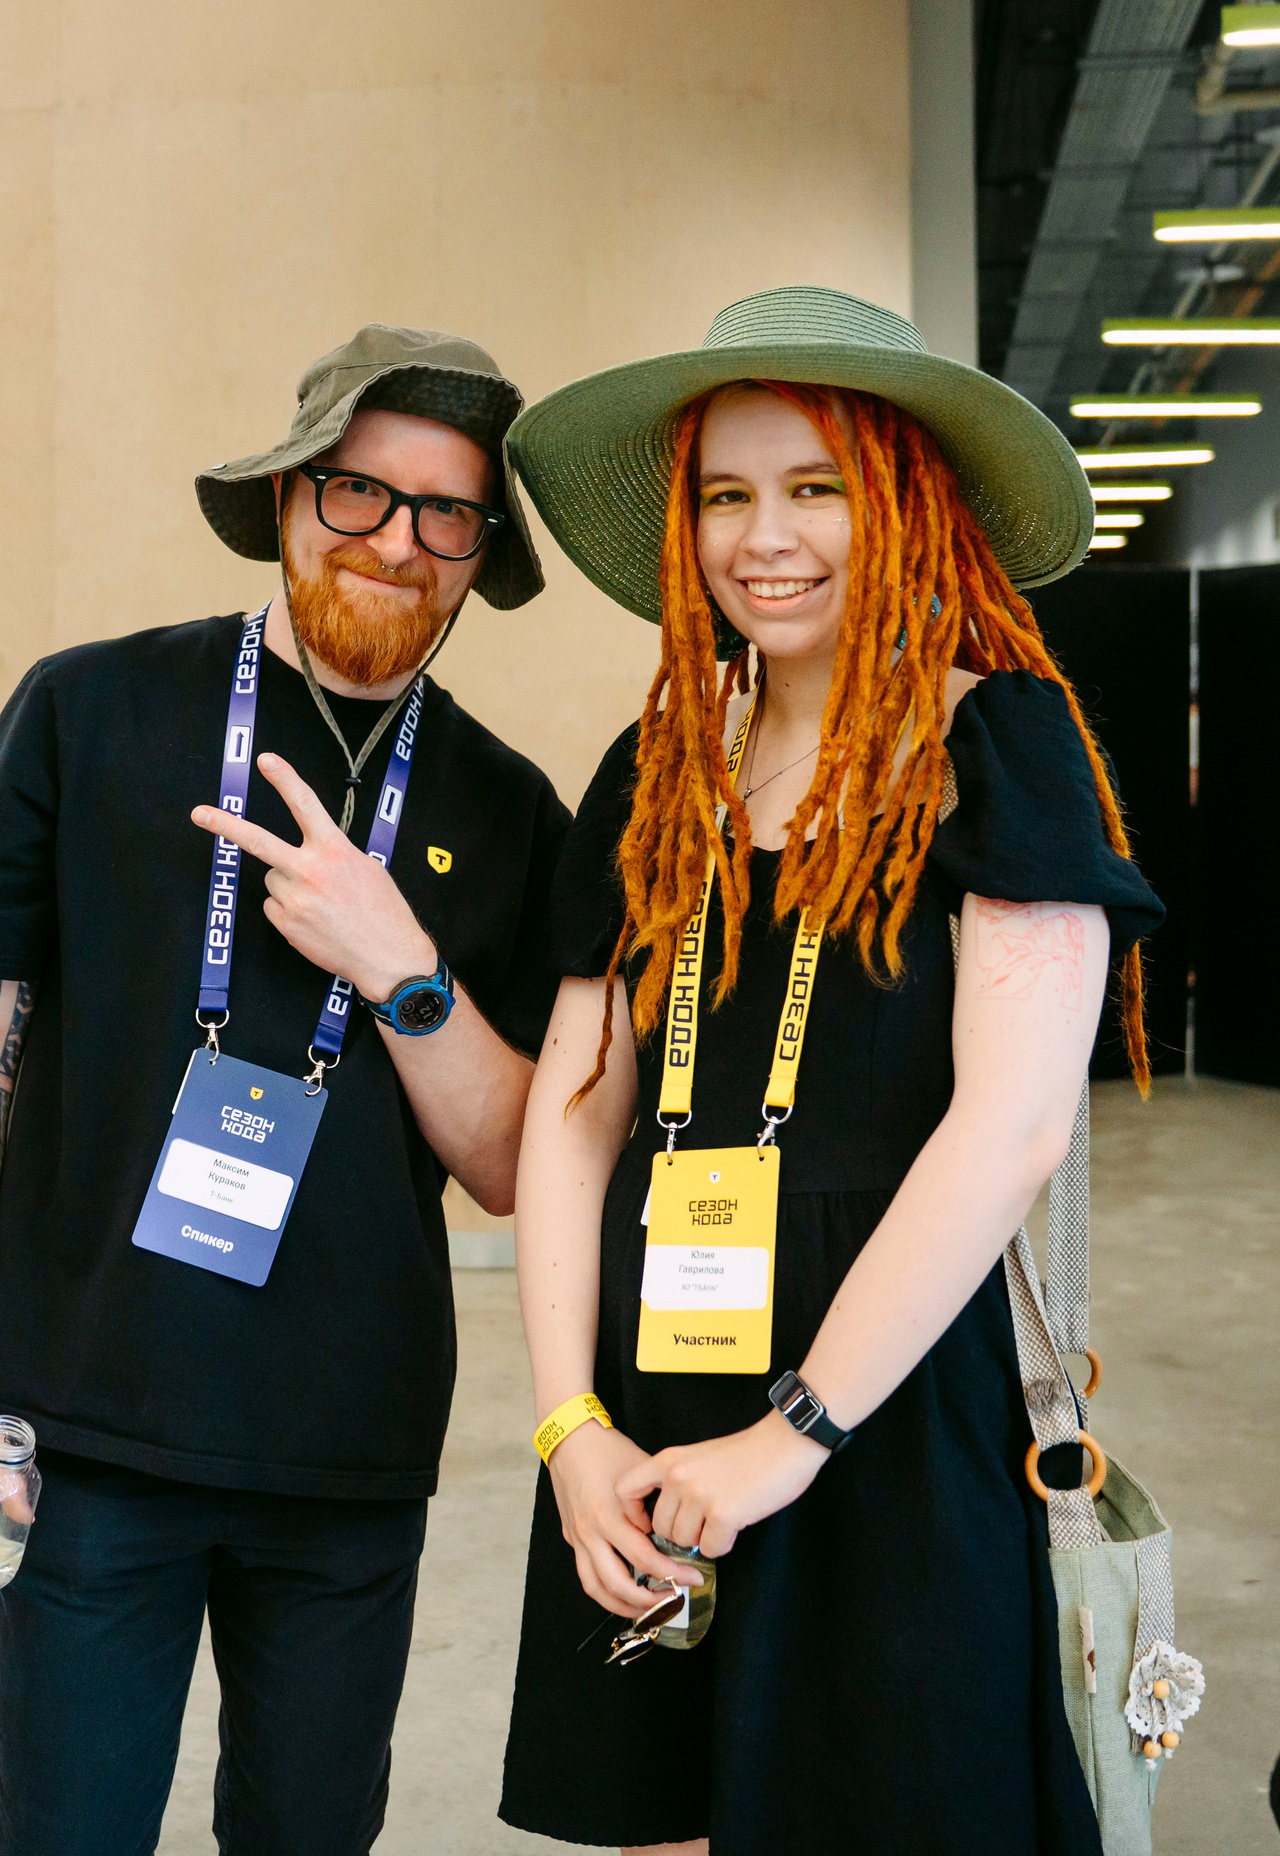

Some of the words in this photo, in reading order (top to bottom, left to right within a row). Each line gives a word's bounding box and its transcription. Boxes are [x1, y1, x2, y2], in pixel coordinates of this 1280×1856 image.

[396, 695, 422, 762] кода
[207, 871, 236, 965] сезон
[779, 957, 813, 1061] сезон
[669, 986, 695, 1067] кода
[221, 1105, 275, 1133] сезон
[221, 1119, 266, 1144] кода
[213, 1158, 250, 1178] Максим
[208, 1171, 246, 1191] Кураков
[210, 1190, 234, 1205] Т-Банк
[688, 1199, 738, 1212] сезон
[692, 1213, 733, 1226] кода
[181, 1224, 234, 1253] Спикер
[690, 1250, 715, 1260] Юлия
[678, 1264, 724, 1275] Гаврилова
[673, 1333, 737, 1346] Участник
